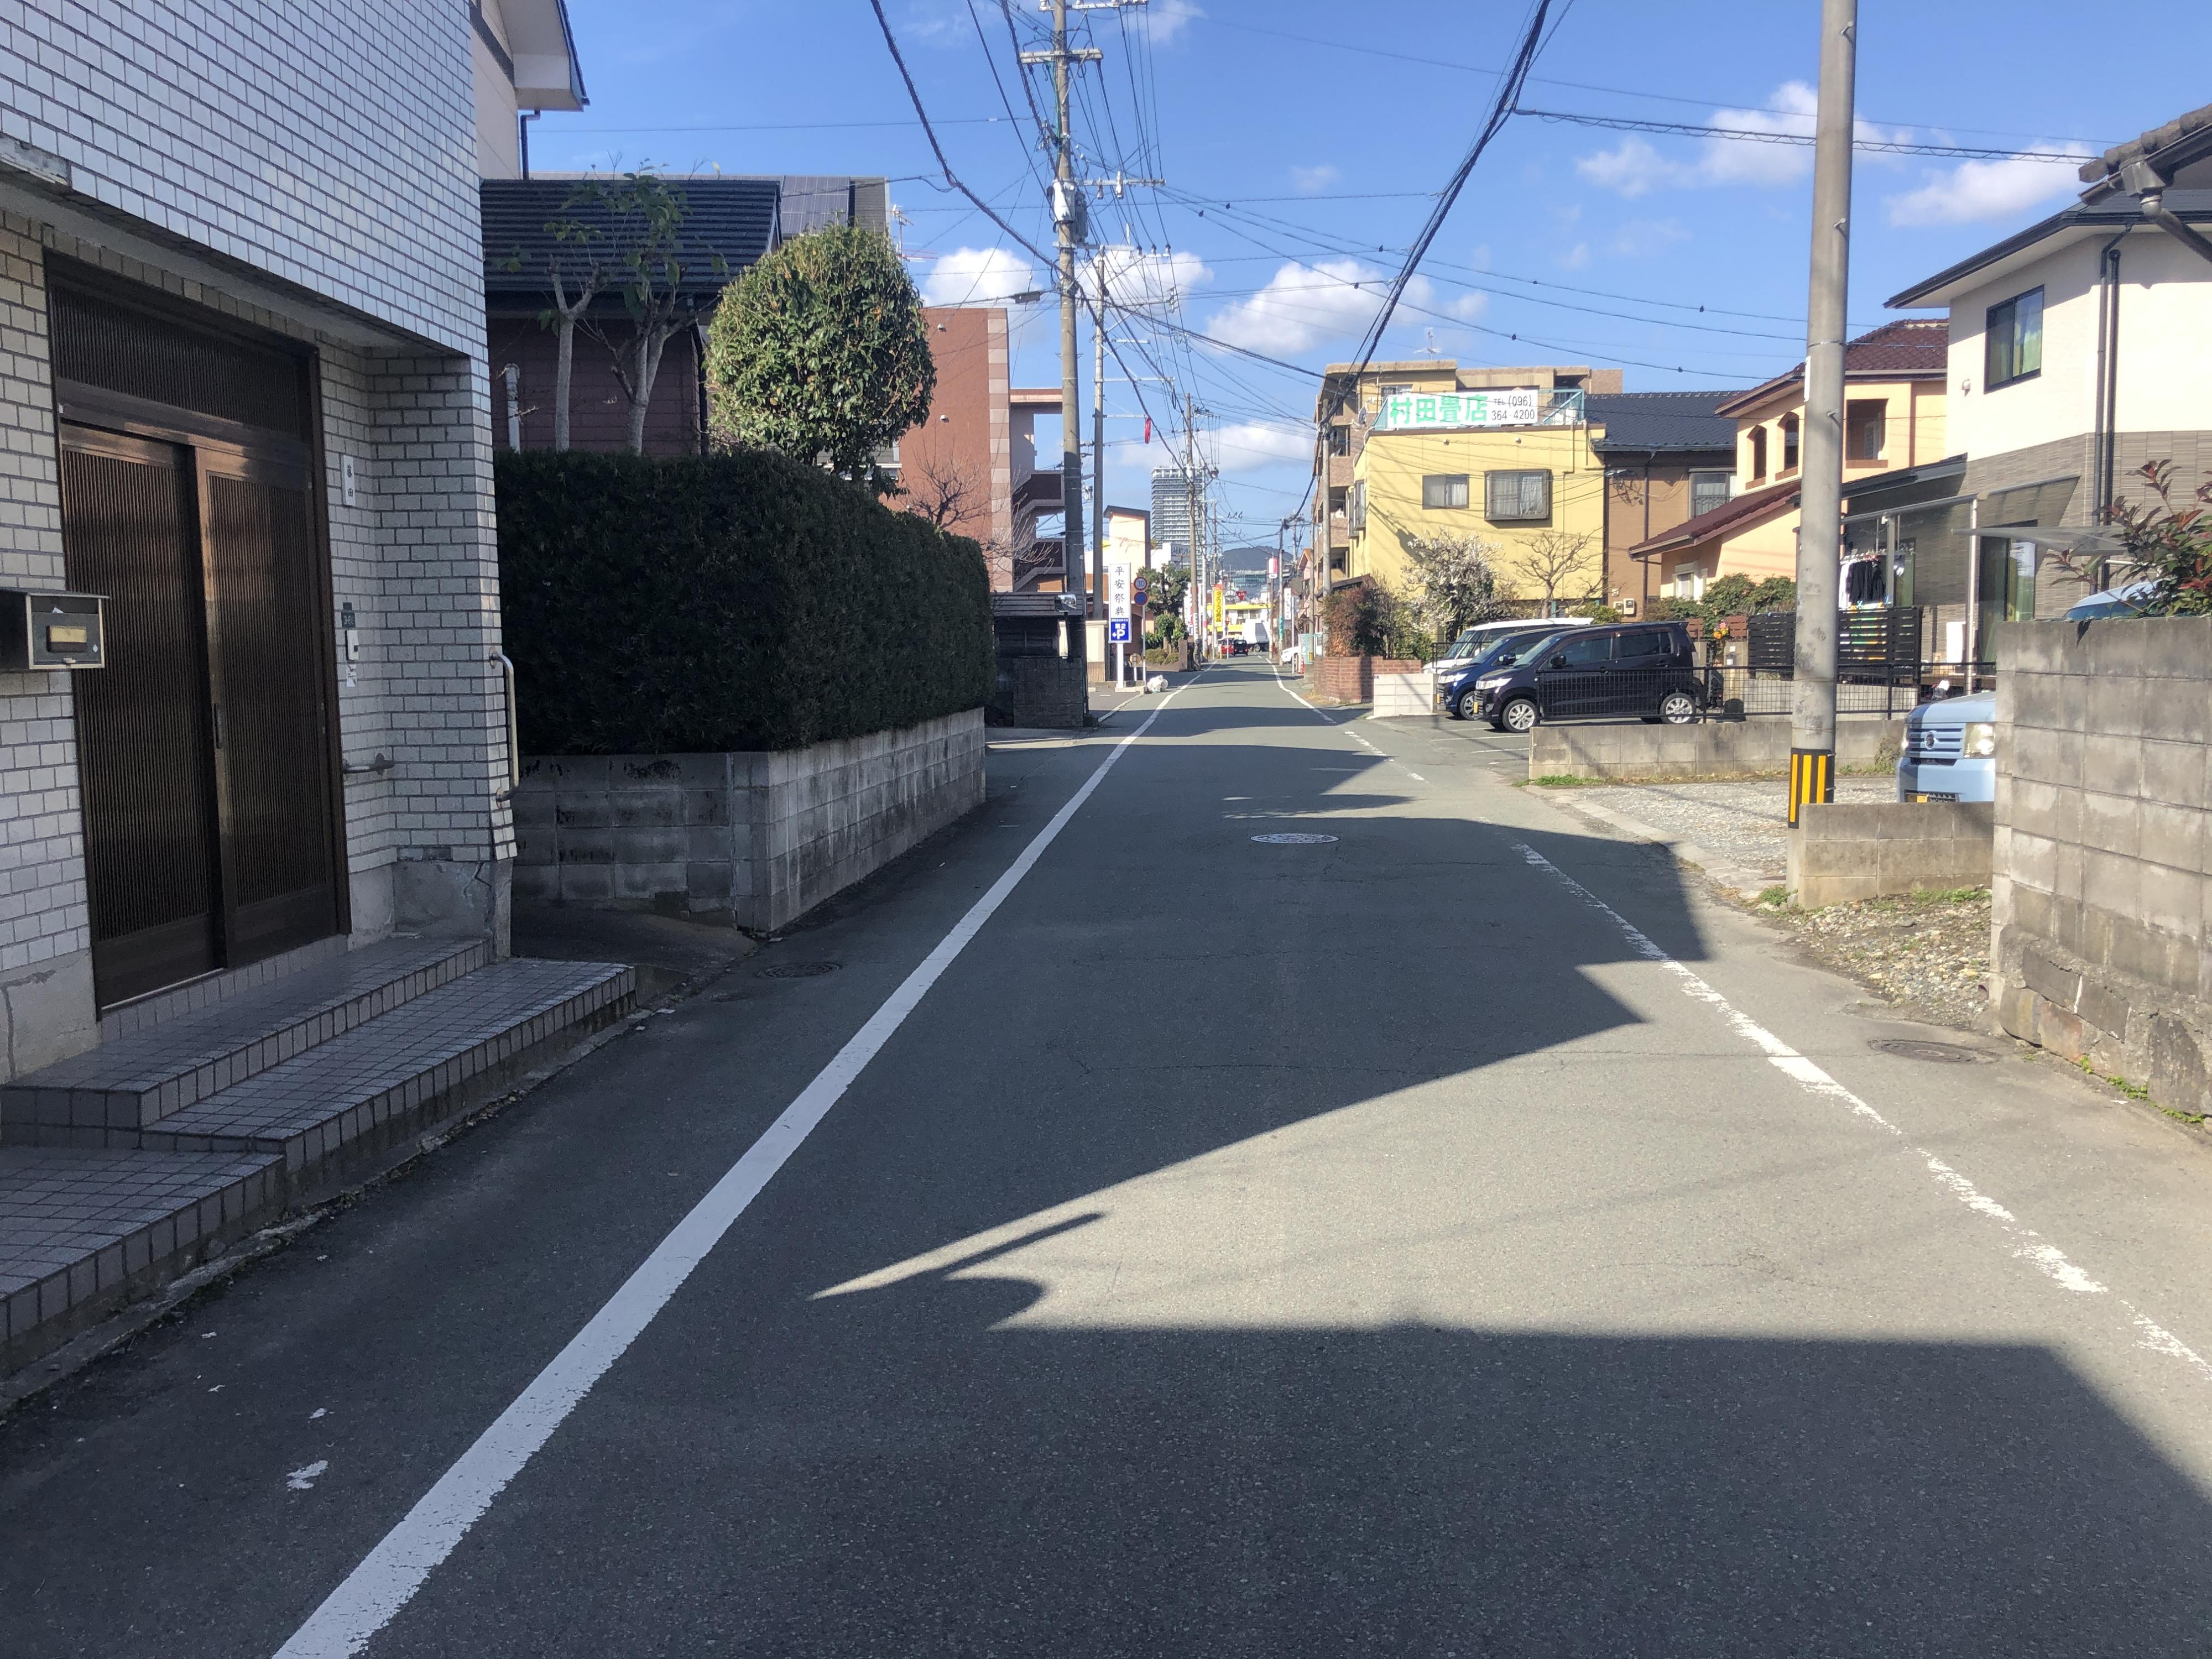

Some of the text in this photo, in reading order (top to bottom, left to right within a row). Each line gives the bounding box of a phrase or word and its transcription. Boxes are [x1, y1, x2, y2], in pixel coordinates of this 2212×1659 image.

[1390, 394, 1488, 424] 村田畳店
[1509, 395, 1531, 408] (096)
[1114, 566, 1125, 615] 平安祭典
[1117, 629, 1125, 640] P
